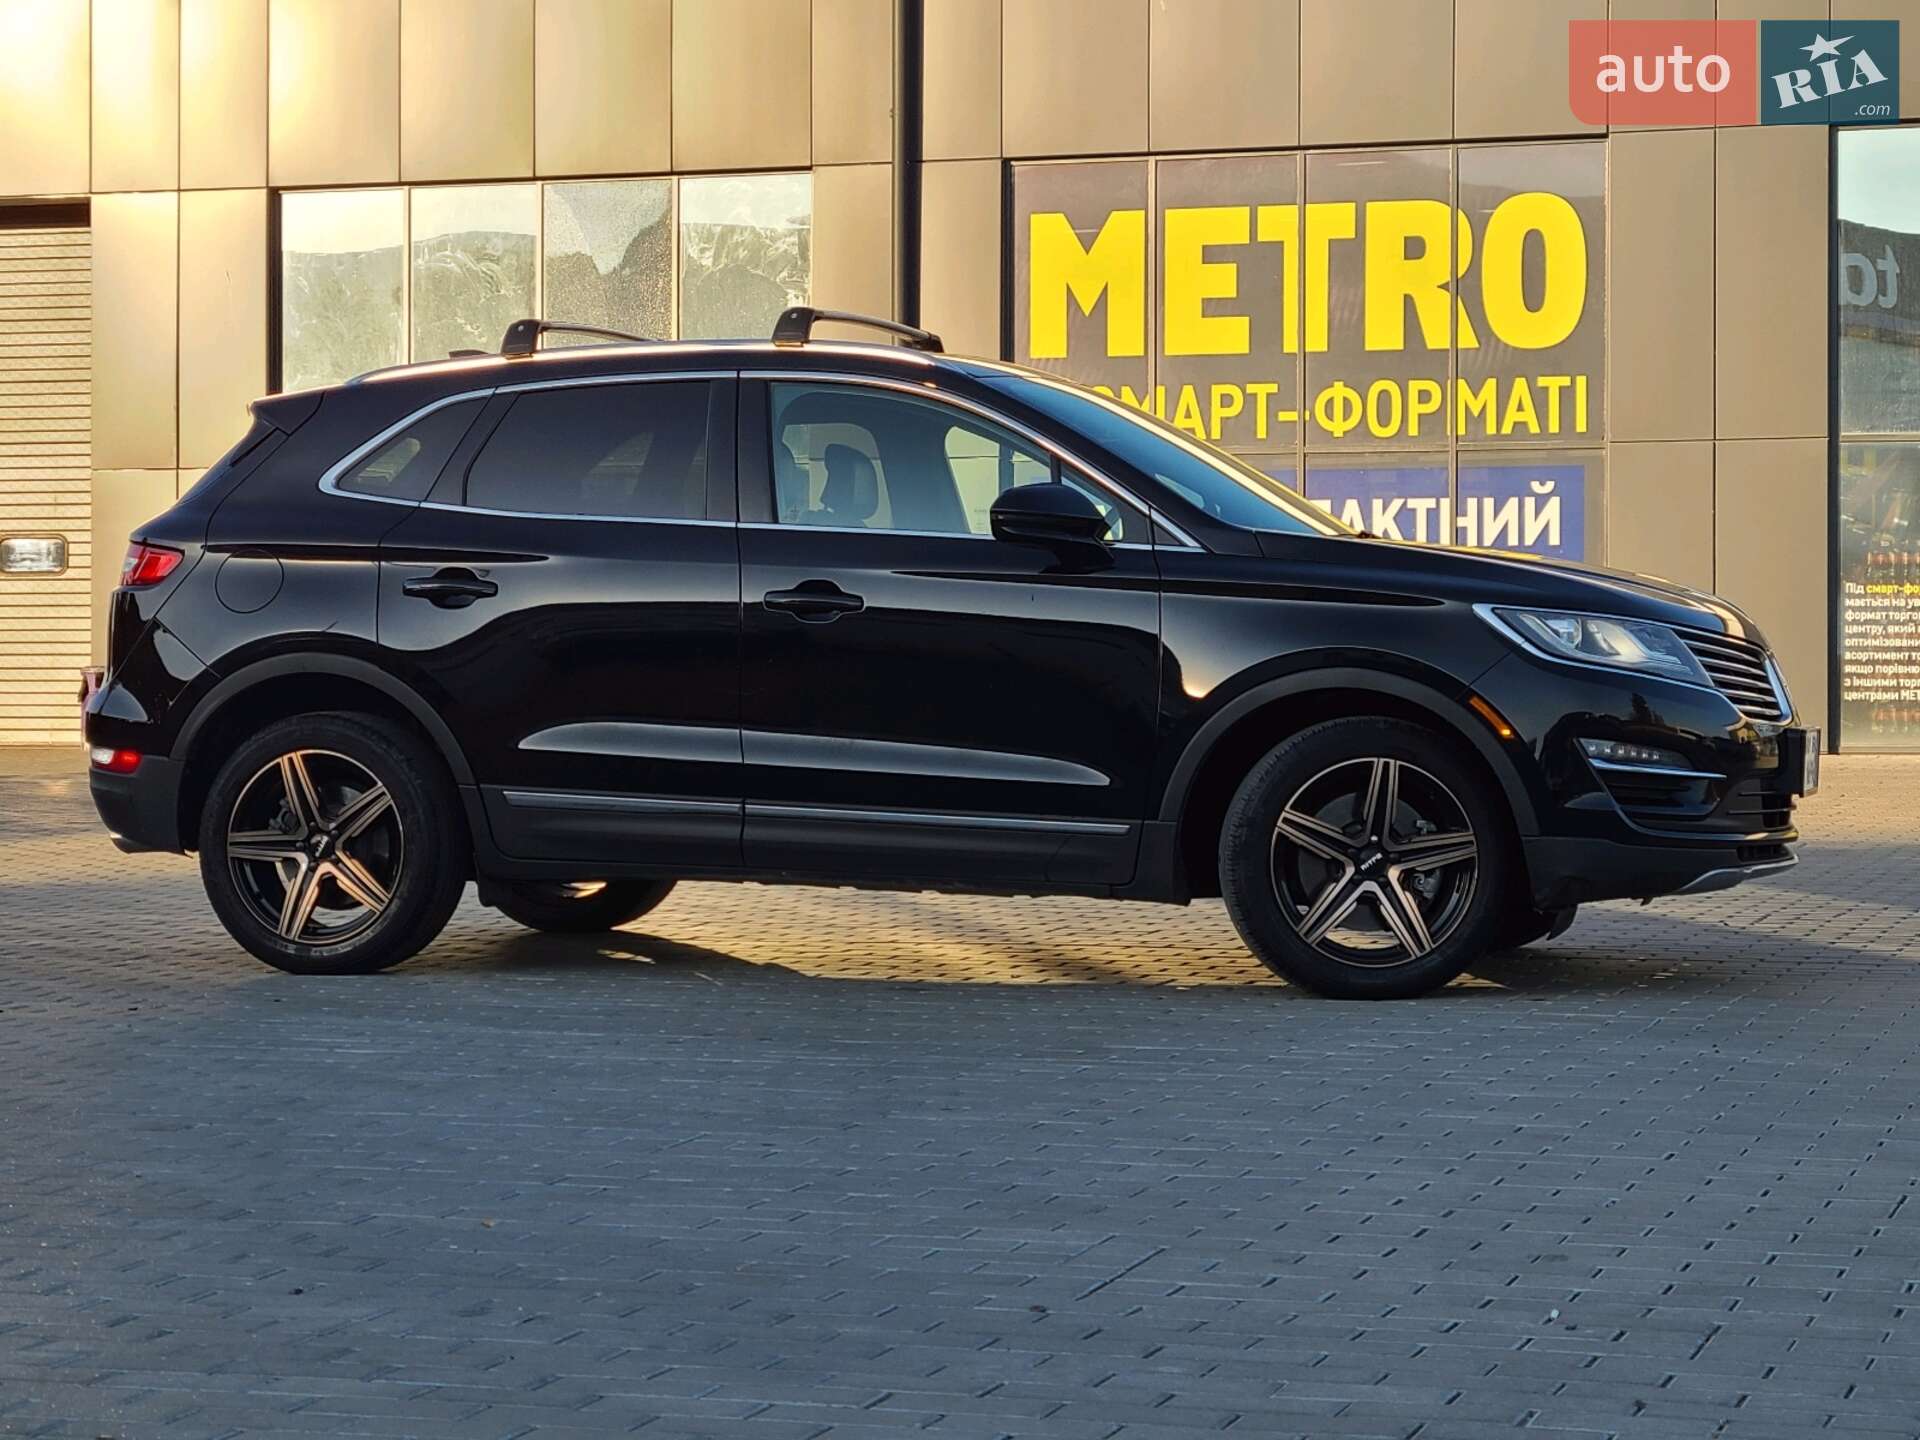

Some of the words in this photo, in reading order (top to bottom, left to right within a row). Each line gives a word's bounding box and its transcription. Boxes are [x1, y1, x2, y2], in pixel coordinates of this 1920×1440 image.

[1029, 191, 1588, 359] METRO
[1092, 375, 1587, 440] МАРТ-ФОРМАТІ
[1845, 582, 1865, 594] Під
[1866, 583, 1920, 595] смарт-фо
[1845, 609, 1887, 622] формат
[1889, 611, 1920, 622] торго
